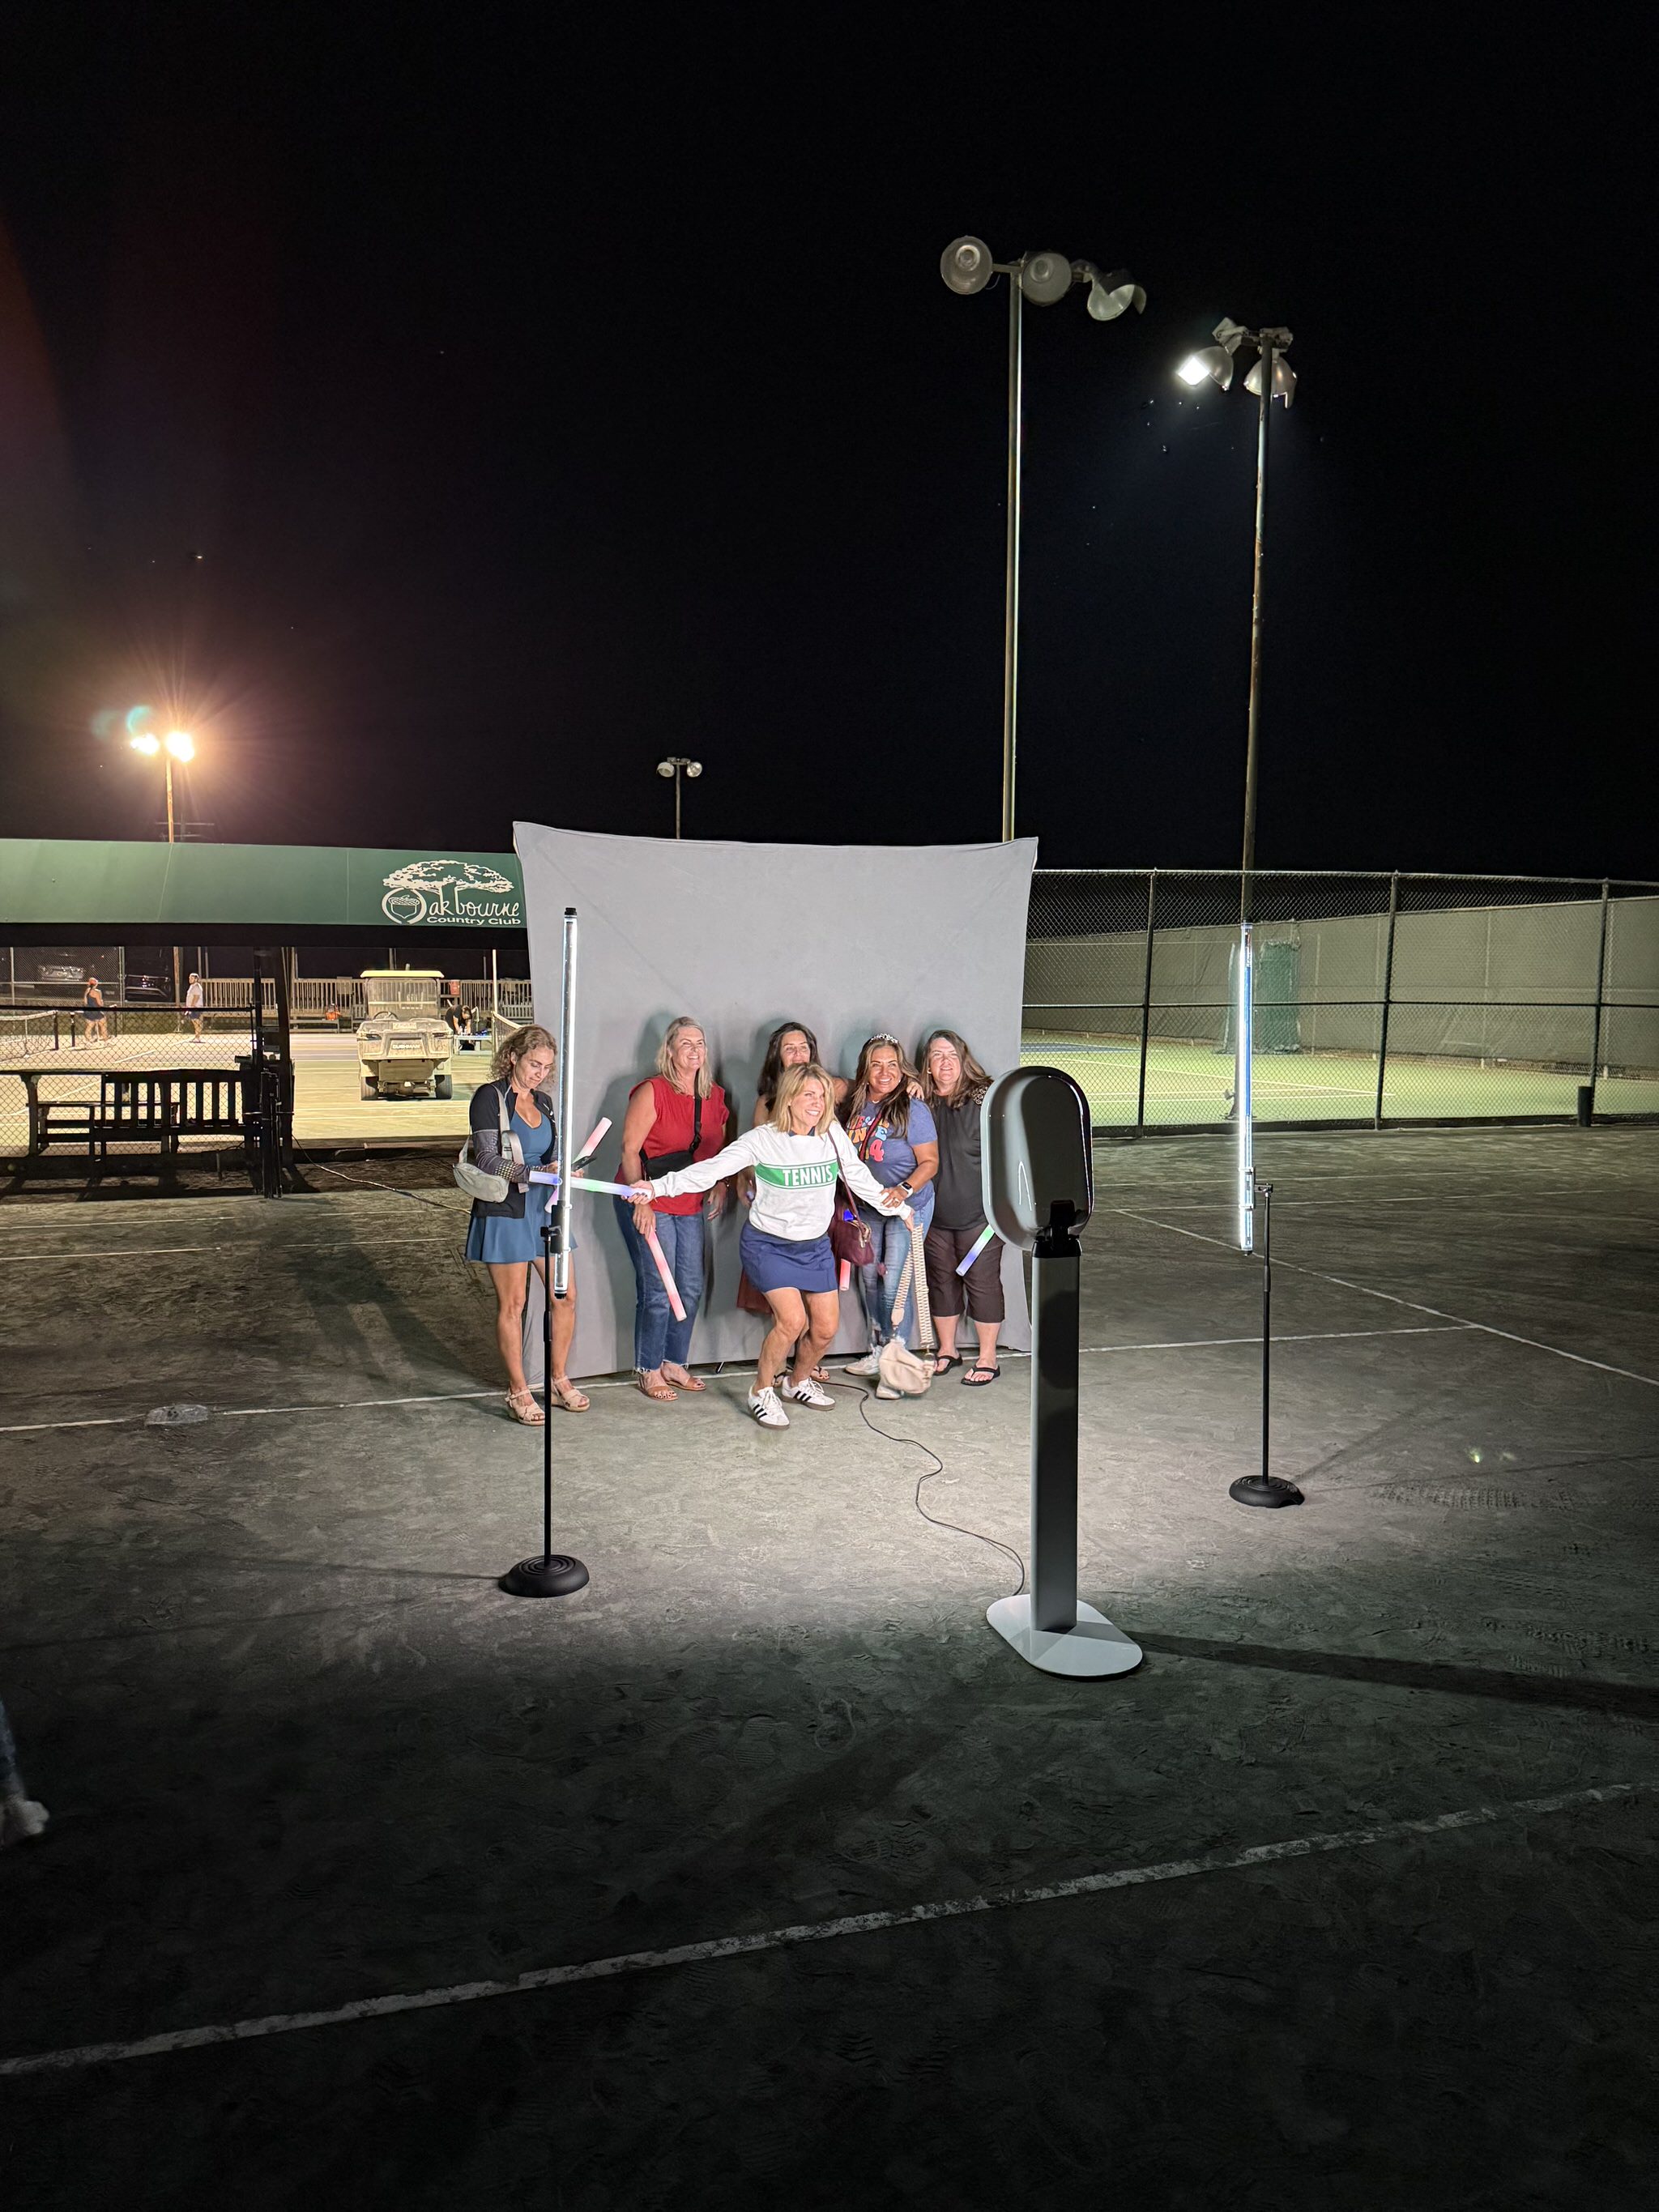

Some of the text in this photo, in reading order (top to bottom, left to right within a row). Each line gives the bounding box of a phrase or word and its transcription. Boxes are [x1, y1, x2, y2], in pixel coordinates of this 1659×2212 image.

[426, 916, 522, 925] Country Club
[783, 1165, 832, 1186] TENNIS
